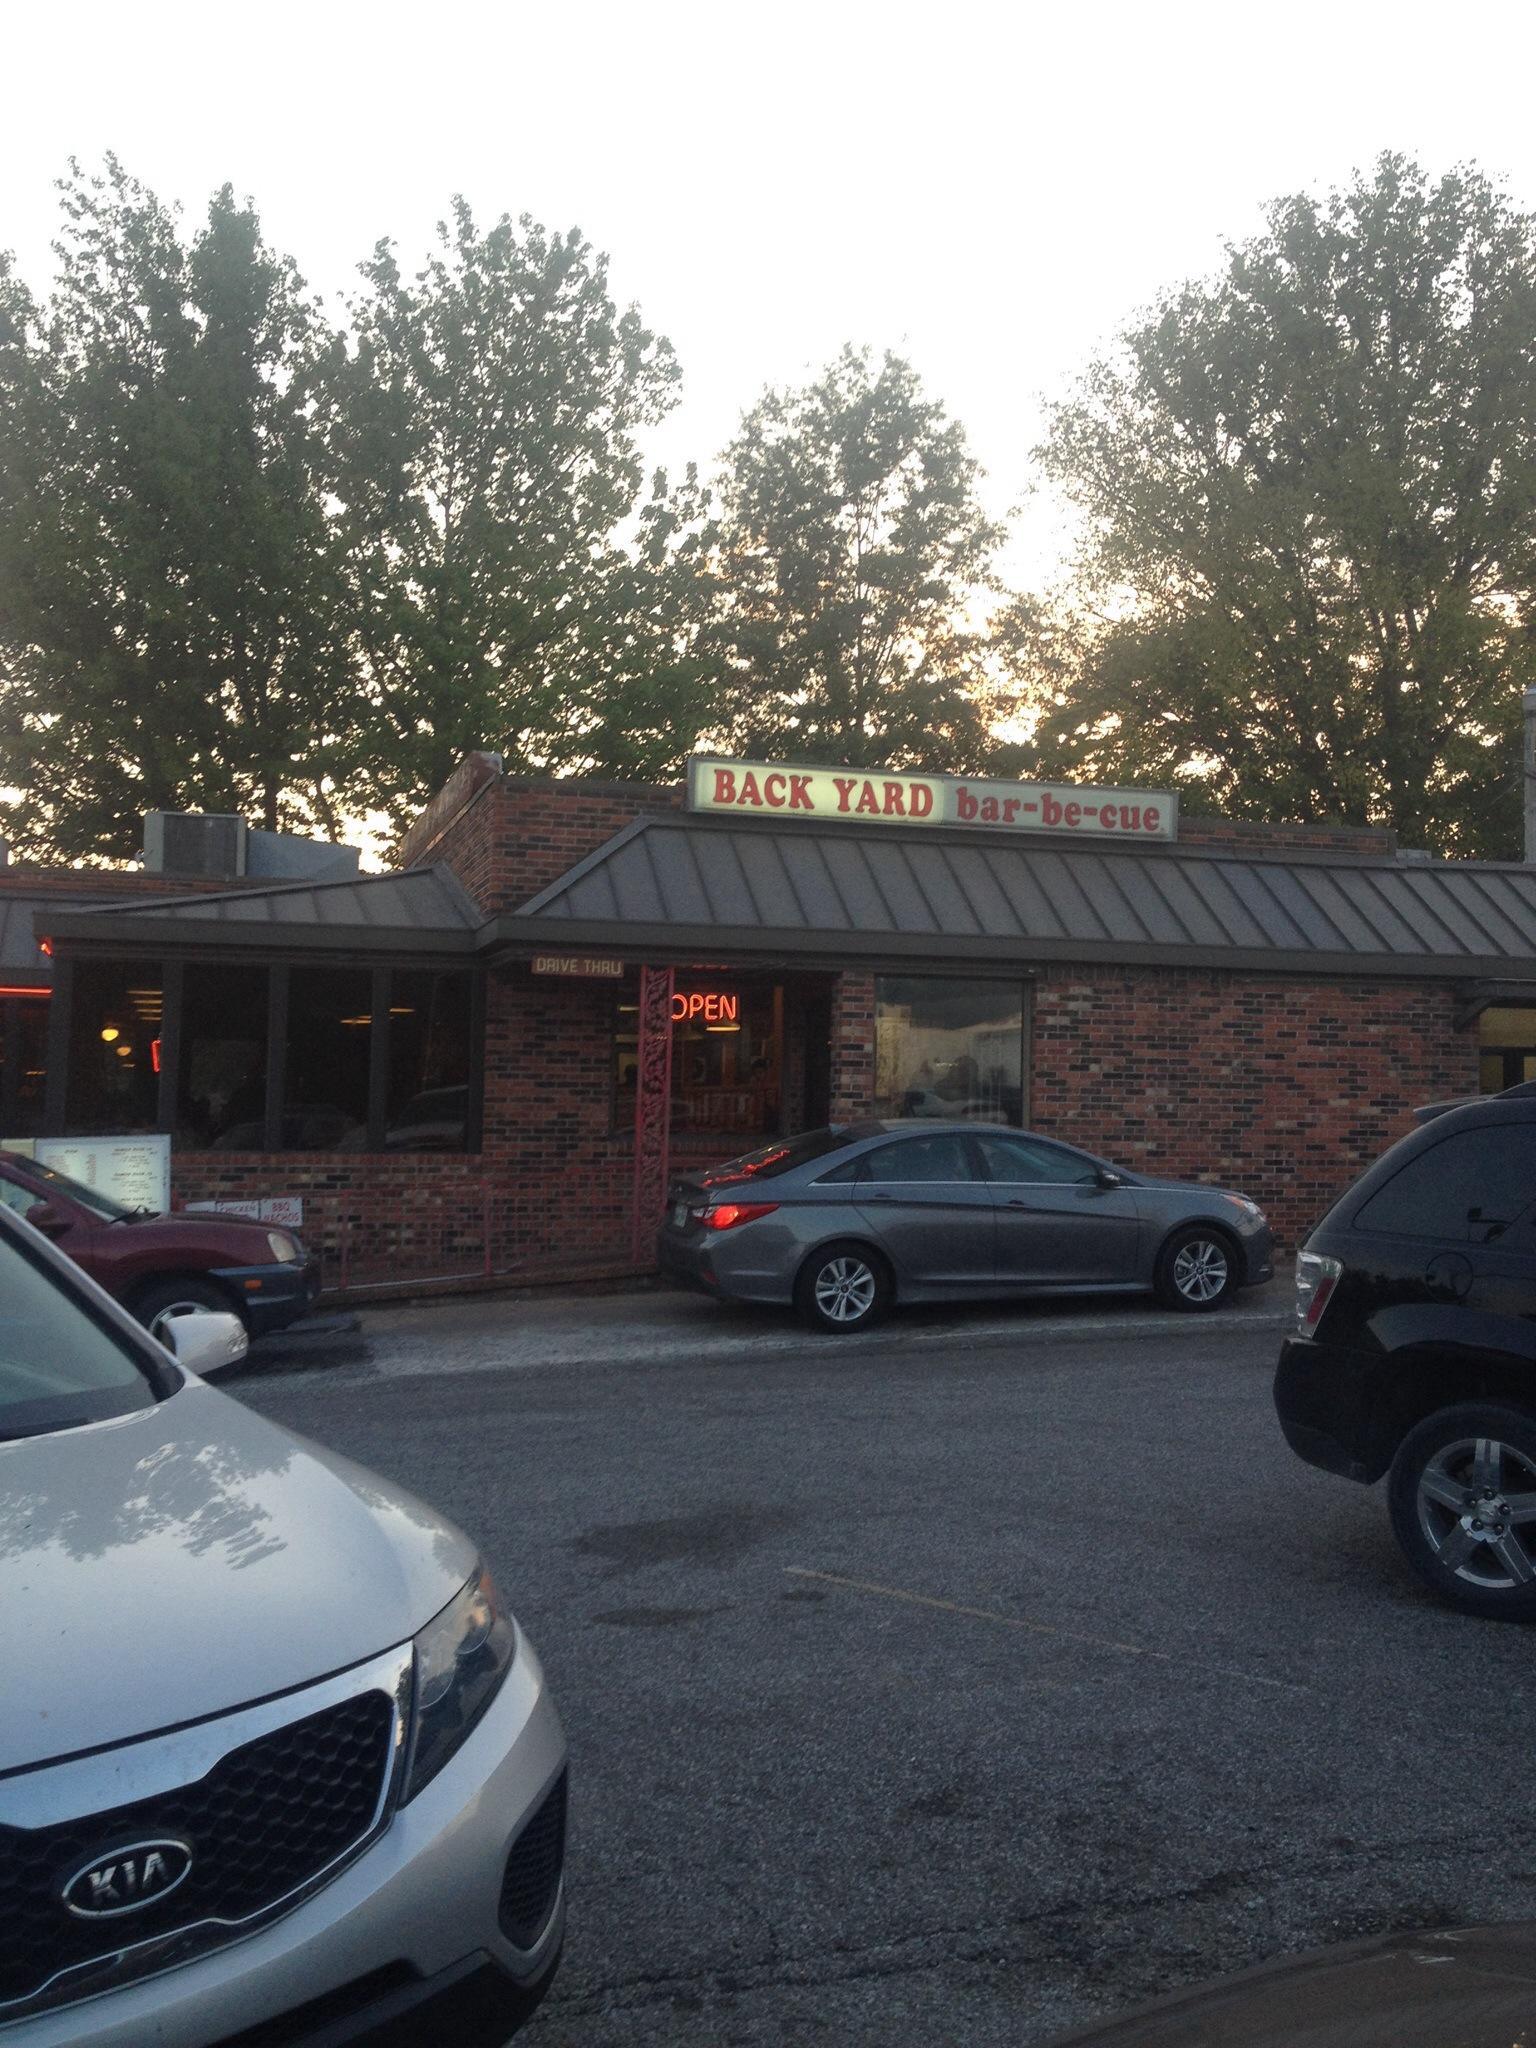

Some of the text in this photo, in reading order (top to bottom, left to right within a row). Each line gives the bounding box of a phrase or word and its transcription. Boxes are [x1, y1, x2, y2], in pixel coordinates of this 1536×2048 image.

[713, 768, 934, 817] BACK YARD
[956, 786, 1160, 832] bar-be-cue
[536, 957, 622, 975] DRIVE THRU
[671, 993, 736, 1020] OPEN
[272, 1202, 290, 1212] BBQ
[87, 1852, 170, 1903] KIA
